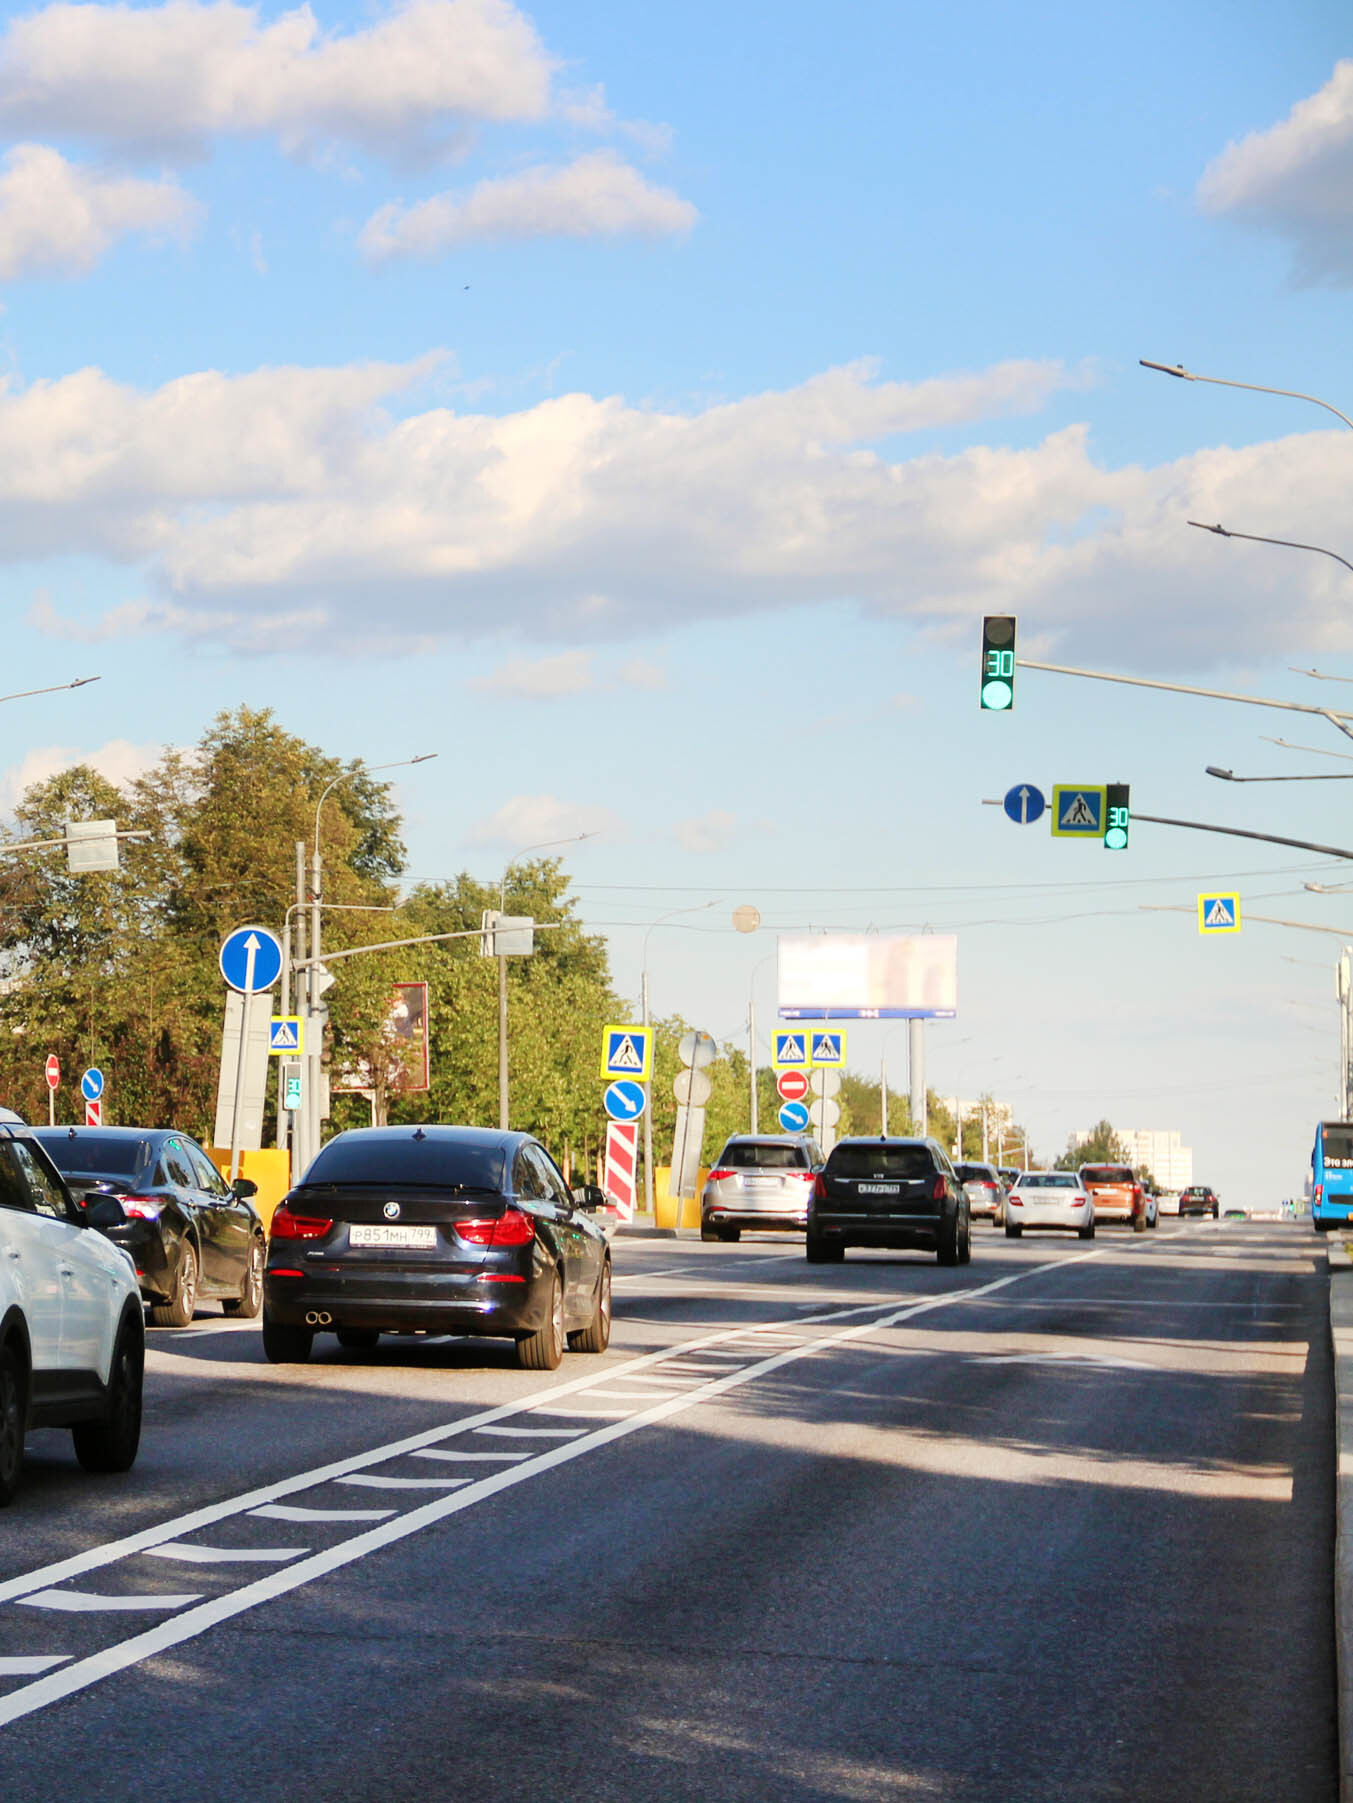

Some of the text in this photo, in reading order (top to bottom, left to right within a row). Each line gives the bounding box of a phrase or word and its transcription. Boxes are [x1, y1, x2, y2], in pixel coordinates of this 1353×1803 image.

[987, 650, 1014, 677] 30
[1110, 807, 1128, 827] 30
[287, 1078, 301, 1093] 30
[411, 1228, 431, 1239] 799
